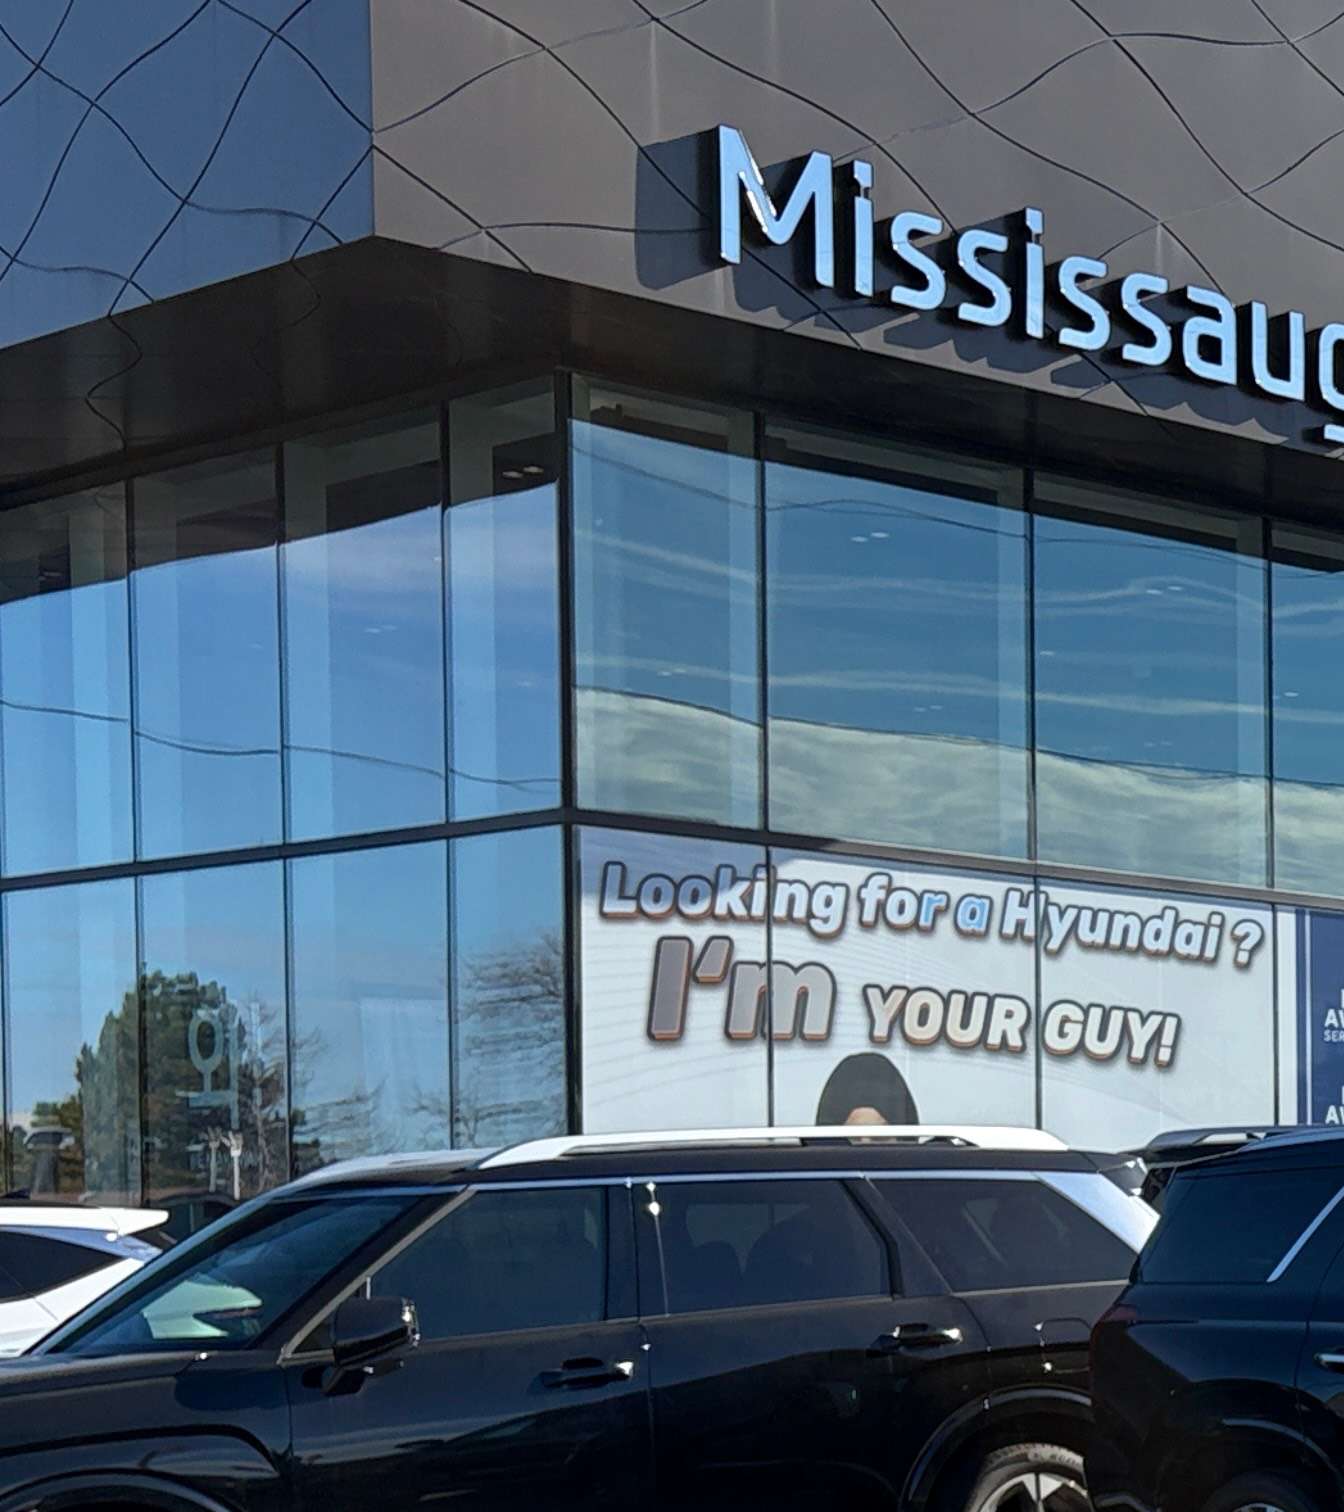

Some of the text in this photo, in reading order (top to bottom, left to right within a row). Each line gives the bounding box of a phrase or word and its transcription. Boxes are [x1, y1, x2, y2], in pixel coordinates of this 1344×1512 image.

[602, 861, 847, 939] Looking
[859, 873, 946, 930] for
[954, 894, 991, 938] a
[647, 936, 1181, 1070] I'm YOUR GUY!
